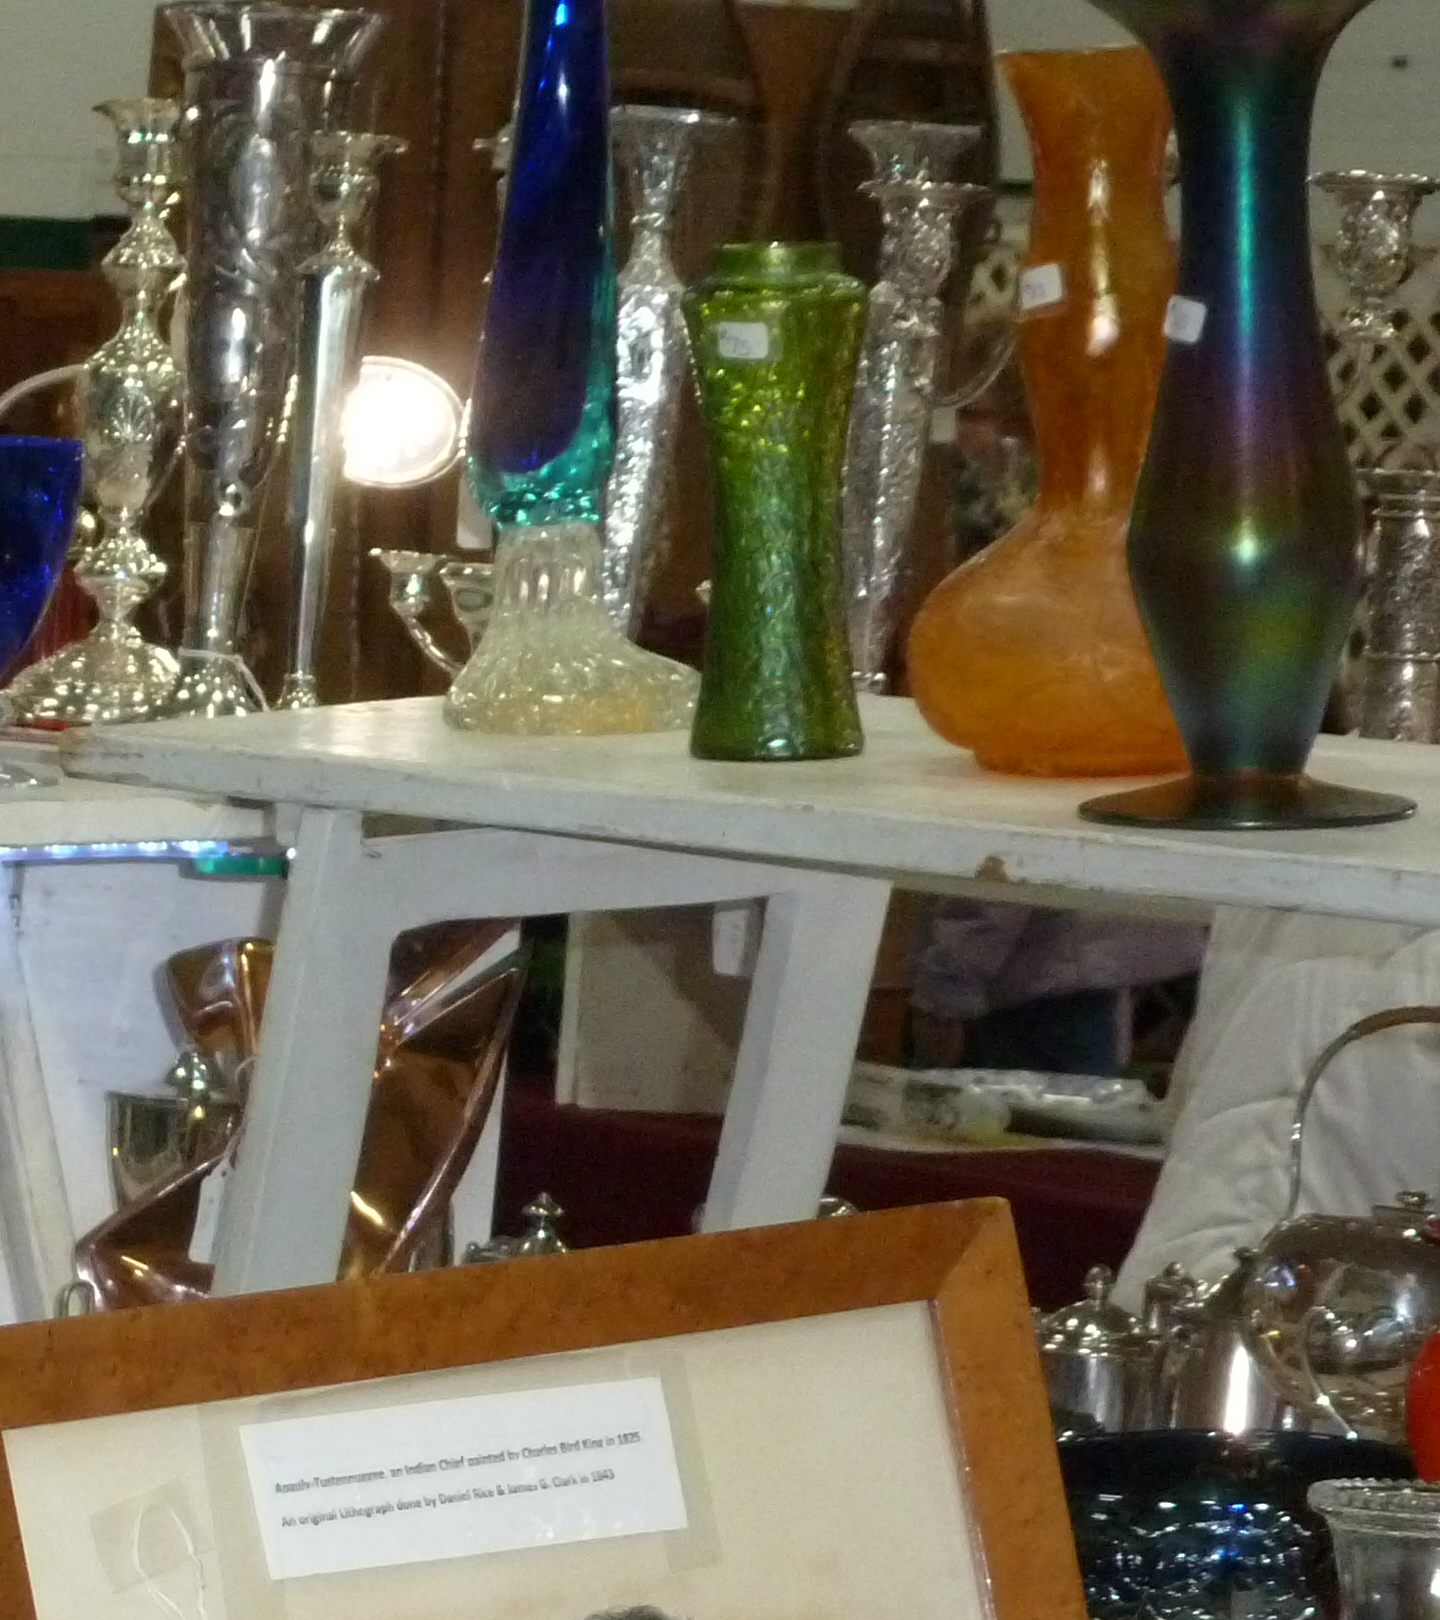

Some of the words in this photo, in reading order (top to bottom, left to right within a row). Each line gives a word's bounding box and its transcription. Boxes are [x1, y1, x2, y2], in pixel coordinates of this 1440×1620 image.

[390, 1468, 403, 1478] an
[405, 1460, 437, 1476] Indian
[439, 1455, 466, 1471] Chief
[508, 1449, 520, 1462] by
[522, 1444, 558, 1460] Charles
[559, 1439, 581, 1454] Bird
[582, 1437, 604, 1451] King
[605, 1435, 615, 1446] in
[281, 1515, 297, 1528] An
[298, 1508, 338, 1526] original
[339, 1500, 395, 1518] Lithograph
[396, 1497, 422, 1511] done
[424, 1495, 437, 1508] by
[437, 1490, 470, 1506] Daniel
[472, 1487, 495, 1501] Rice
[496, 1485, 506, 1497] &
[507, 1482, 538, 1495] James
[539, 1477, 551, 1490] G.
[552, 1474, 578, 1488] Clark
[580, 1472, 590, 1484] in
